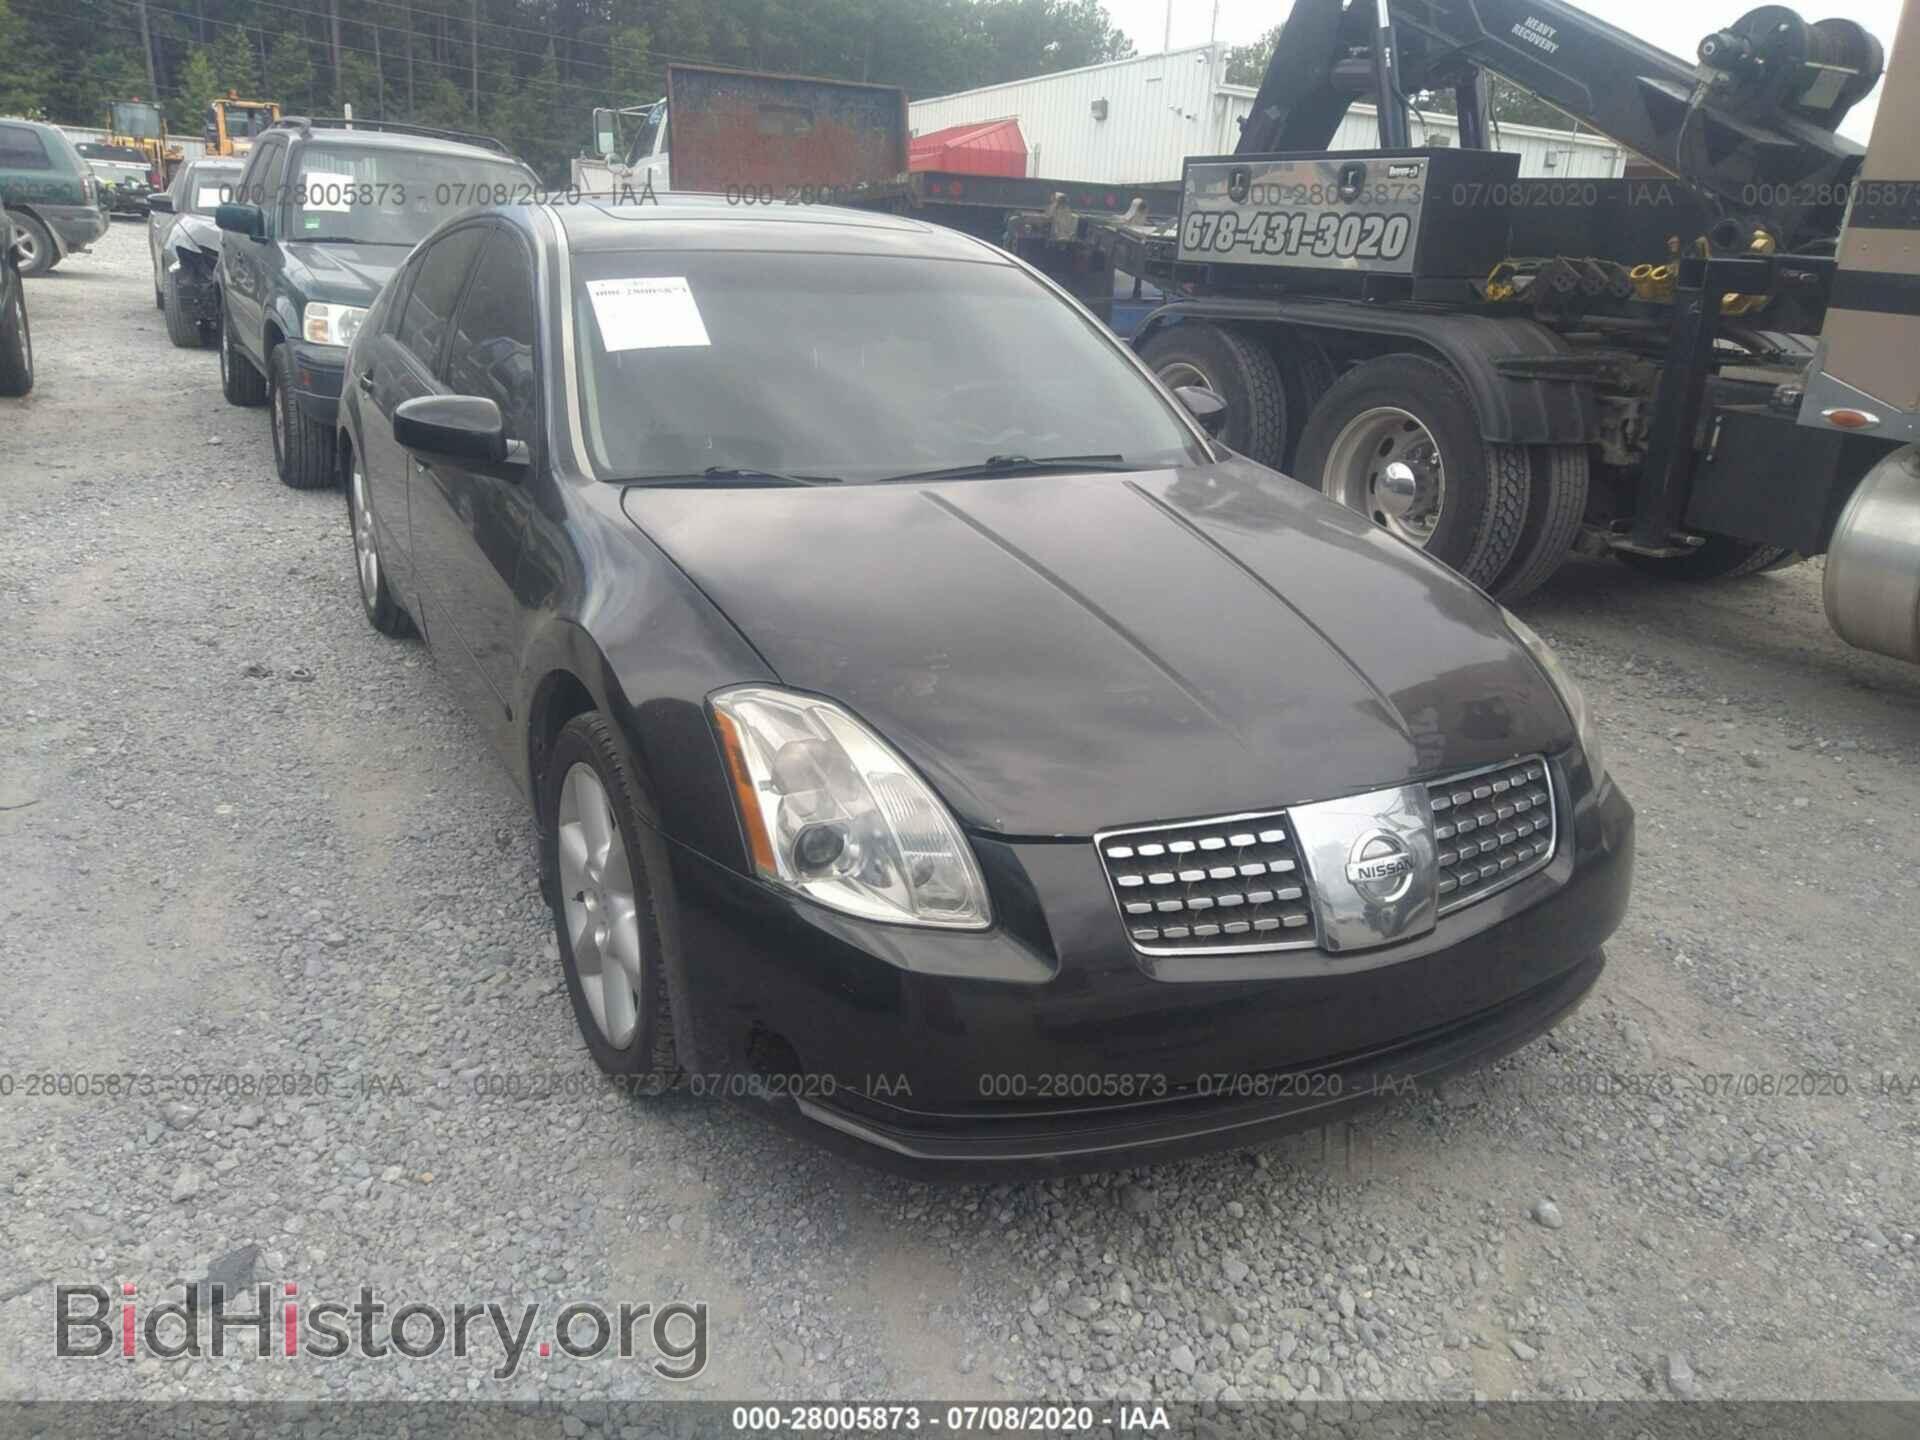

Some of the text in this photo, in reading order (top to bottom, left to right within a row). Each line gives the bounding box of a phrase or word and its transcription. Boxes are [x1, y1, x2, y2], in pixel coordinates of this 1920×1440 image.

[1511, 23, 1560, 54] RECOVERY
[1523, 15, 1558, 38] HEAVY
[1182, 211, 1411, 261] 678-431-3020
[1357, 858, 1415, 880] NISSAN
